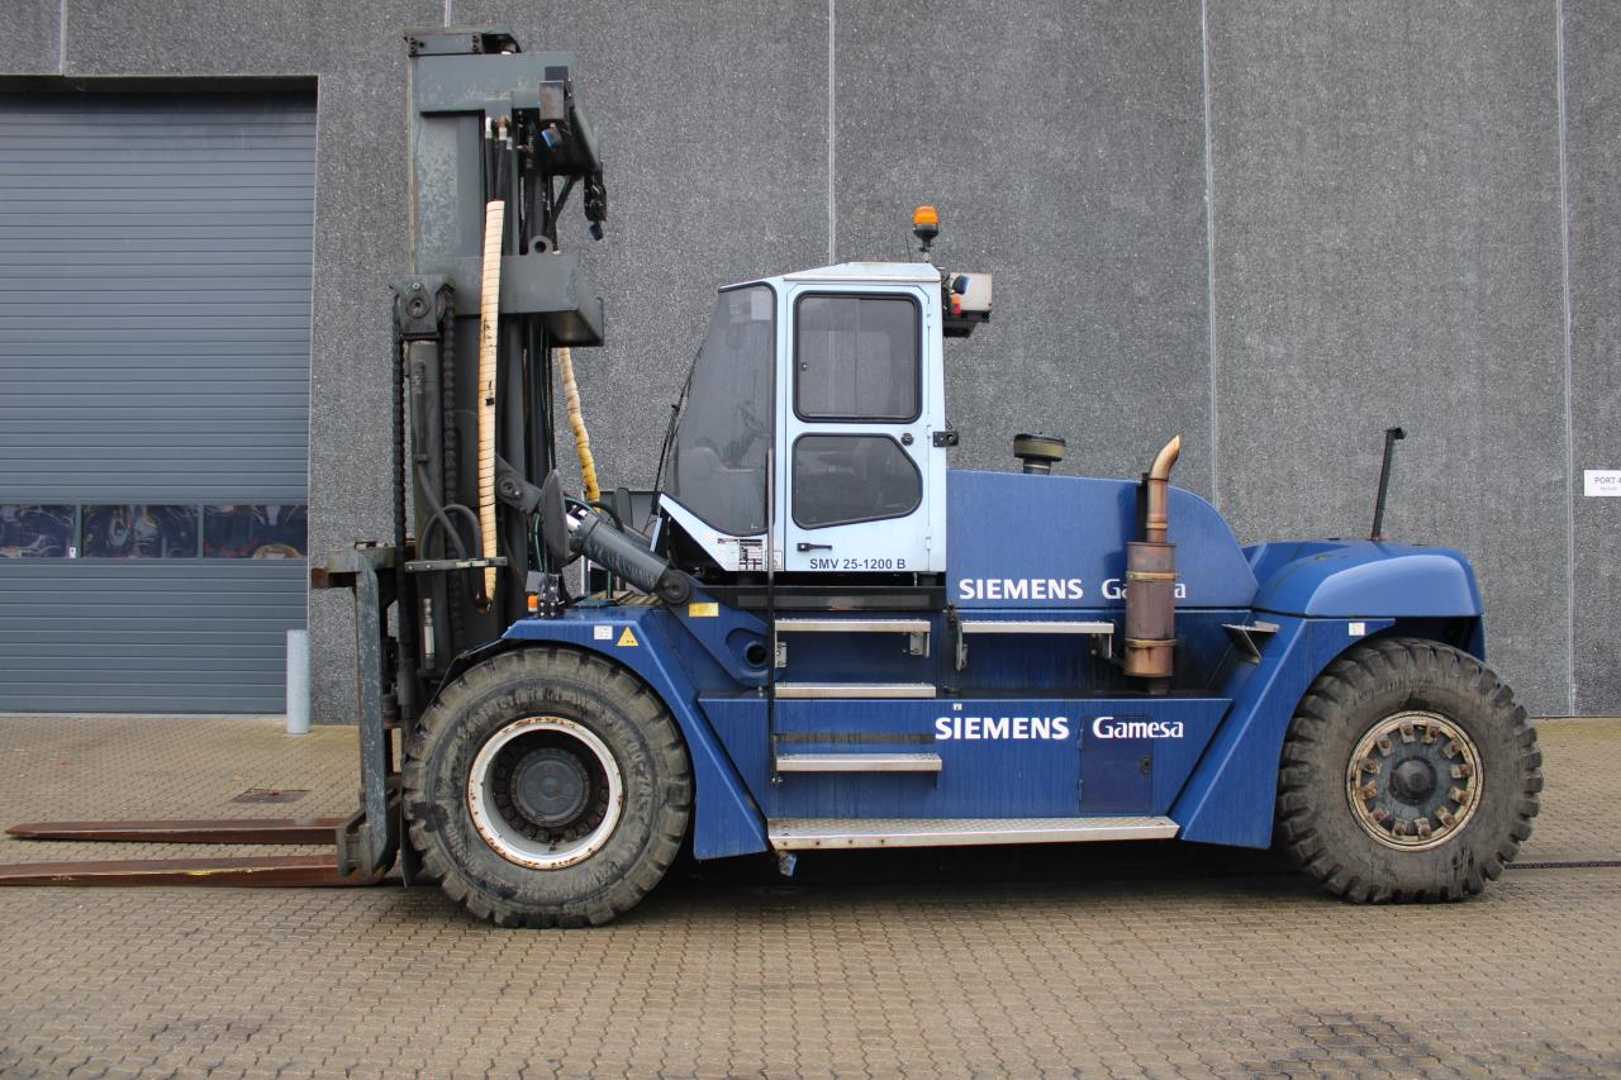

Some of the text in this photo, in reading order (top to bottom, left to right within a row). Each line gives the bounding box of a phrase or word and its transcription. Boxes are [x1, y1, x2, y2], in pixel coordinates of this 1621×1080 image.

[810, 558, 906, 569] SMV 25-1200 B
[959, 578, 1084, 600] SIEMENS
[935, 716, 1184, 741] SIEMENS Gamesa
